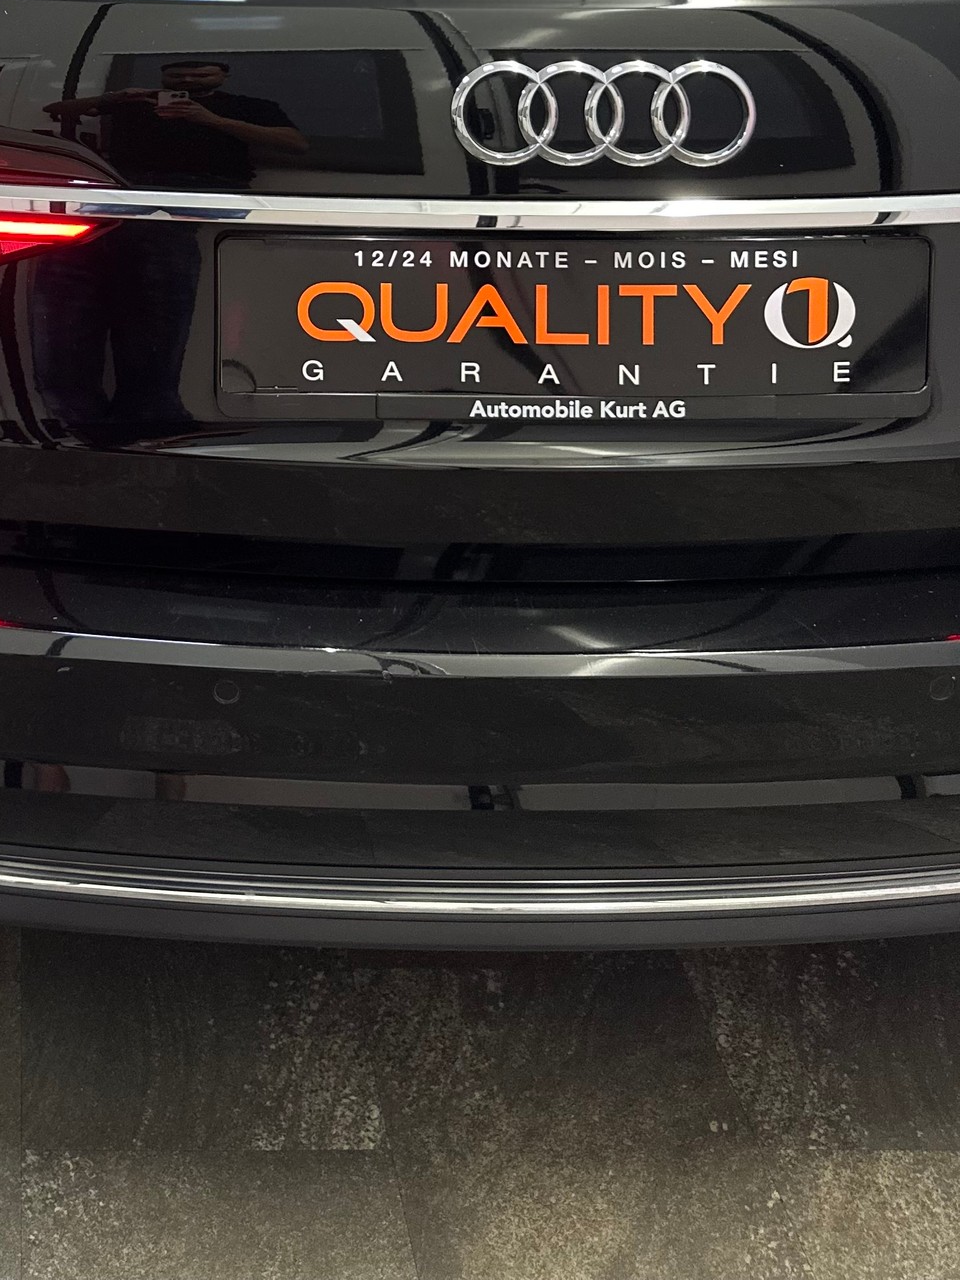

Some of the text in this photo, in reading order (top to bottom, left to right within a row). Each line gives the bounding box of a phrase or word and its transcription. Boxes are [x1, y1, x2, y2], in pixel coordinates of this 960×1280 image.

[353, 249, 433, 268] 12/24
[448, 250, 569, 269] MONATE
[613, 250, 687, 269] MOIS
[729, 249, 799, 269] MESI
[296, 280, 753, 346] QUALITY
[301, 358, 852, 386] GARANTIE
[468, 399, 687, 419] Automobile Kurt AG
